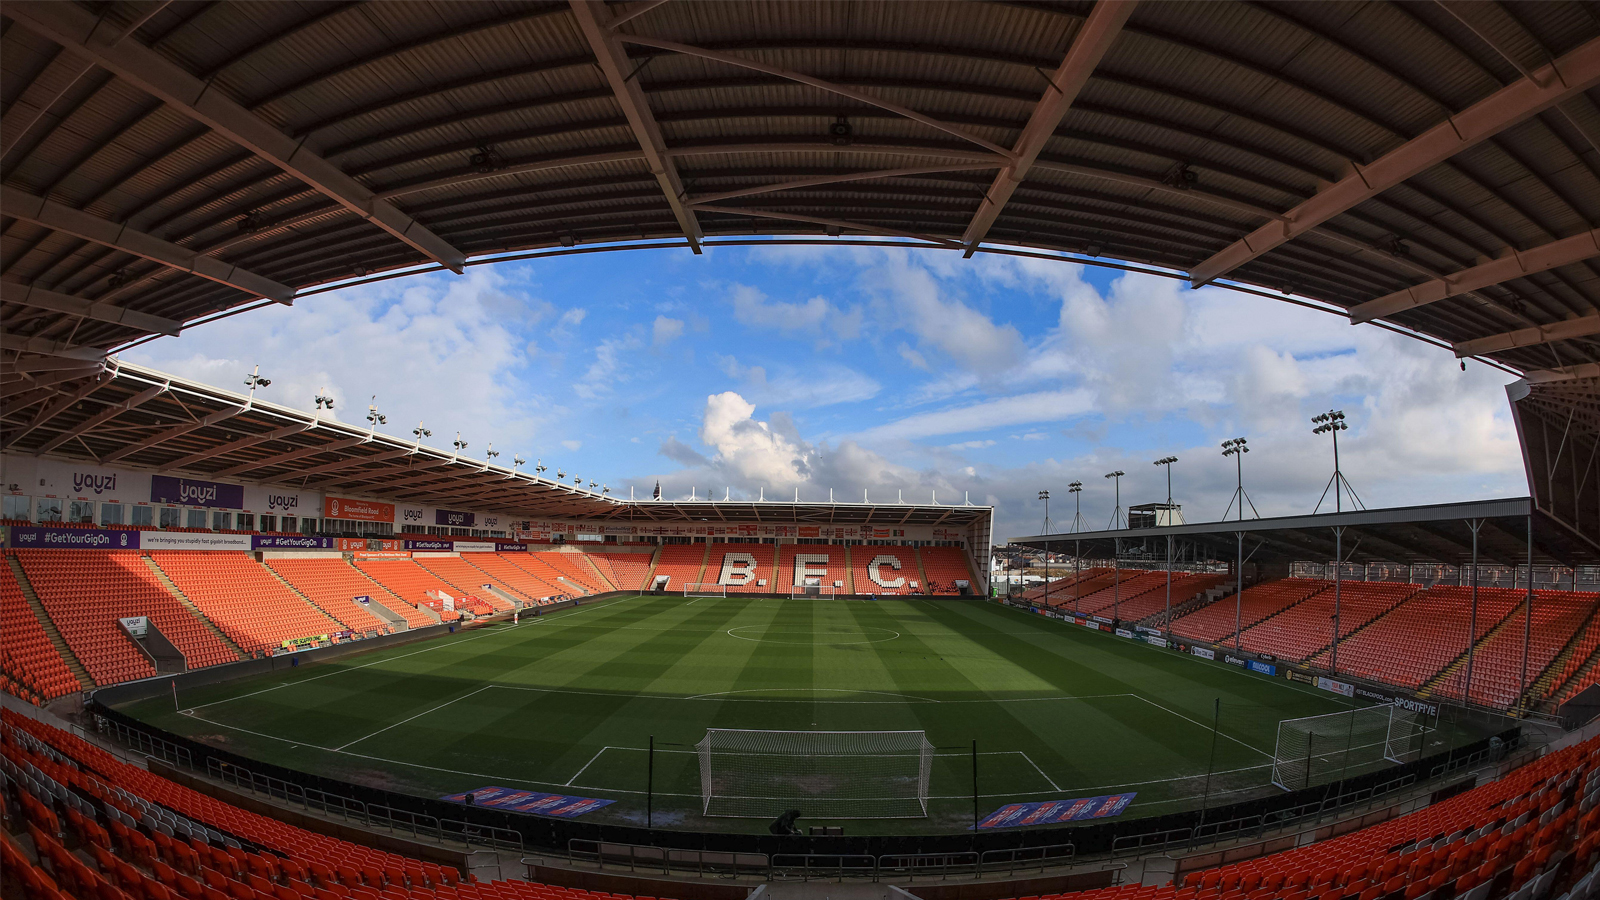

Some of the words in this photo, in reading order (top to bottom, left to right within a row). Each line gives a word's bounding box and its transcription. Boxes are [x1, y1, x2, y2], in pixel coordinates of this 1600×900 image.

[73, 472, 117, 494] yayzi
[180, 484, 217, 504] yayzi
[268, 494, 299, 511] yayzi
[404, 509, 423, 521] yayzi
[448, 513, 464, 525] yayzi
[484, 517, 498, 527] yayzi
[19, 532, 37, 543] yayzi
[45, 532, 110, 546] #GetYourGigOn
[275, 538, 318, 548] #GetYourGigOn
[126, 618, 141, 627] yayzi
[1394, 697, 1437, 716] SPORTFIVE
